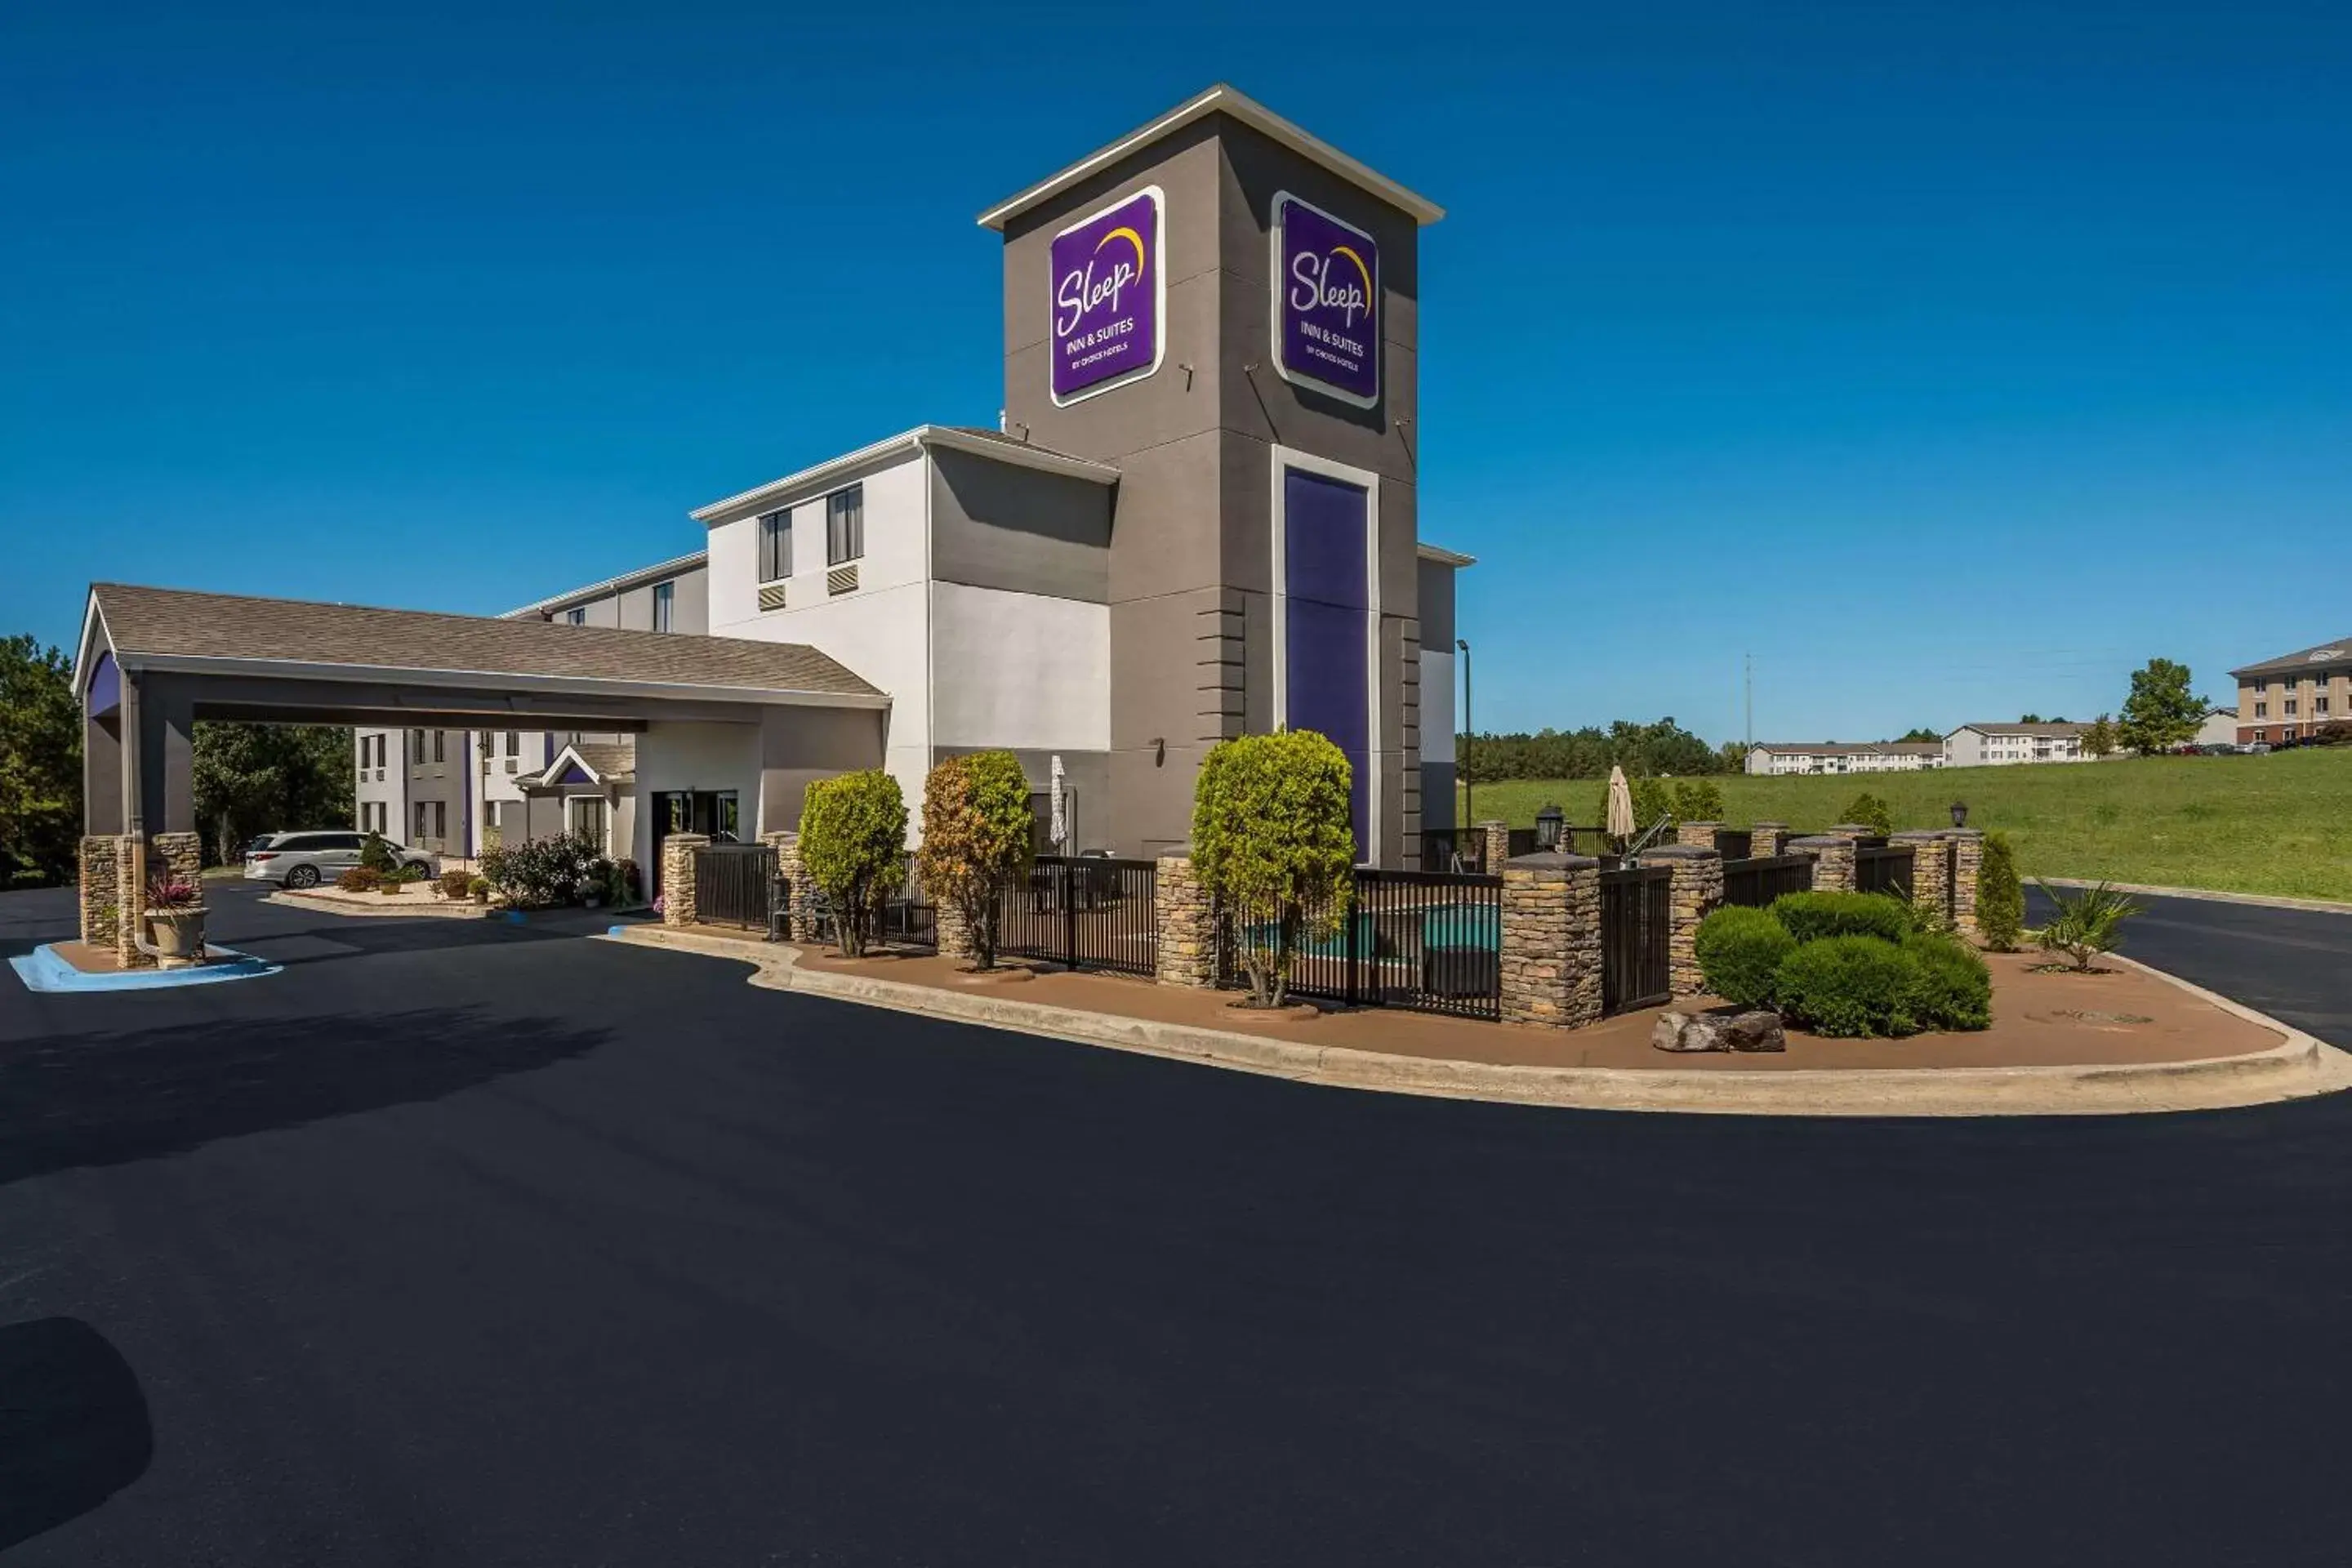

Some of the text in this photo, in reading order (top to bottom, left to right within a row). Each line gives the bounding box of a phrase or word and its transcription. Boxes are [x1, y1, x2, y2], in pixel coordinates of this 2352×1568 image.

[1057, 260, 1135, 337] Sleep
[1290, 251, 1365, 328] Sleep
[1066, 317, 1134, 355] INN & SUITES
[1103, 341, 1129, 357] HOTELS
[1300, 319, 1364, 358] INN & SUITES
